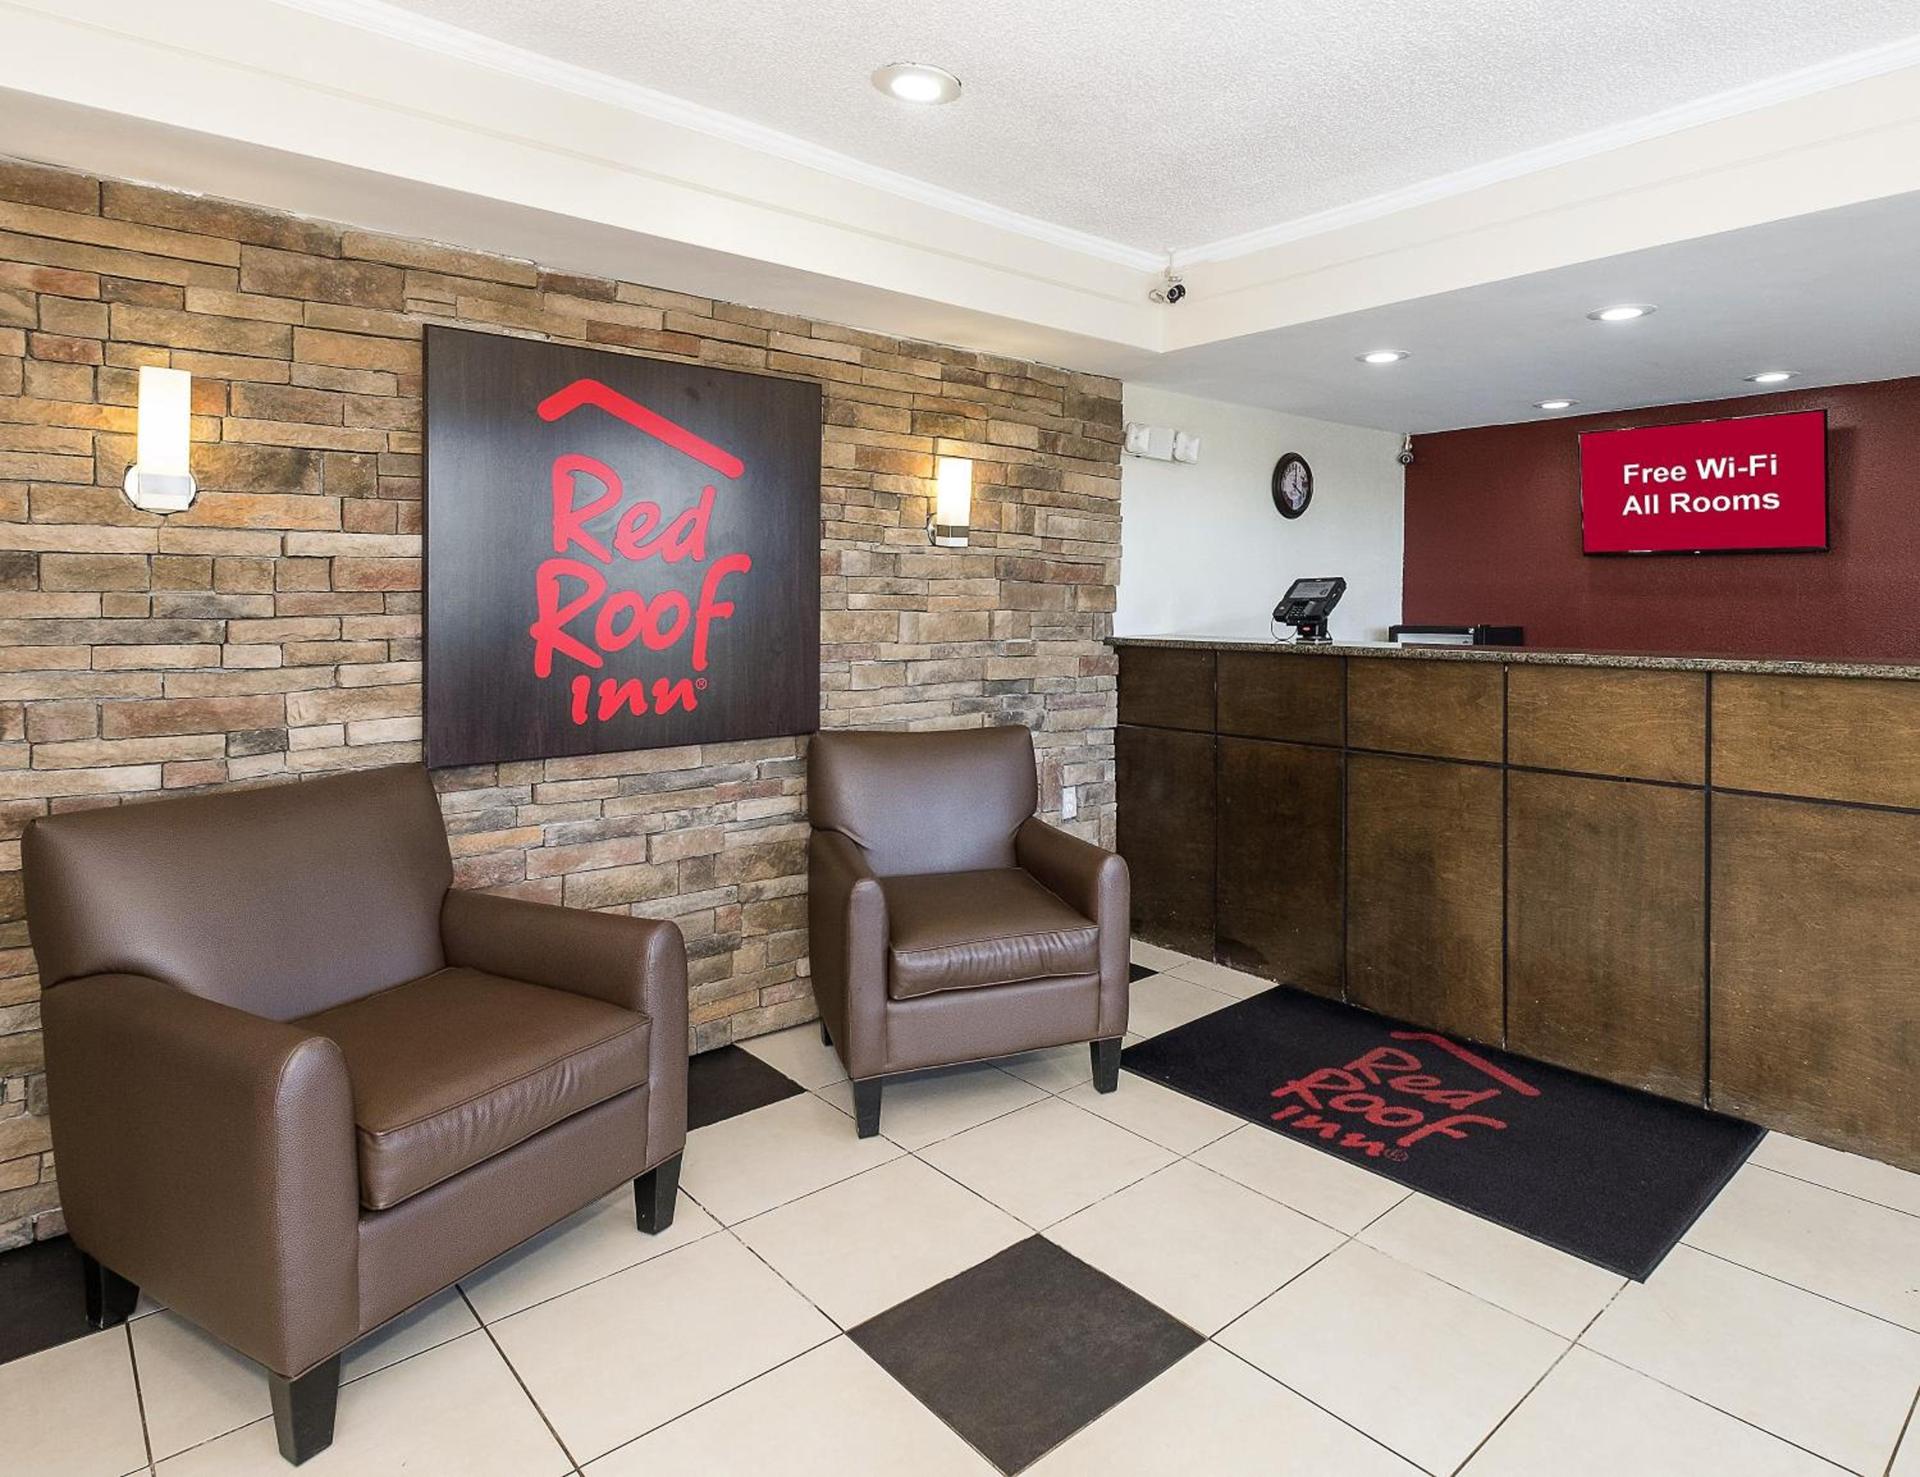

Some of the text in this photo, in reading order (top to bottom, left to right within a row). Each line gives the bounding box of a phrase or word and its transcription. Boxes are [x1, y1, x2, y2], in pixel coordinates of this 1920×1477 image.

[1622, 453, 1778, 485] Free Wi-Fi
[1622, 492, 1781, 516] All Rooms
[552, 453, 717, 564] Red
[529, 553, 752, 679] Roof
[1271, 1067, 1508, 1148] Roof
[1343, 1046, 1502, 1110] Red
